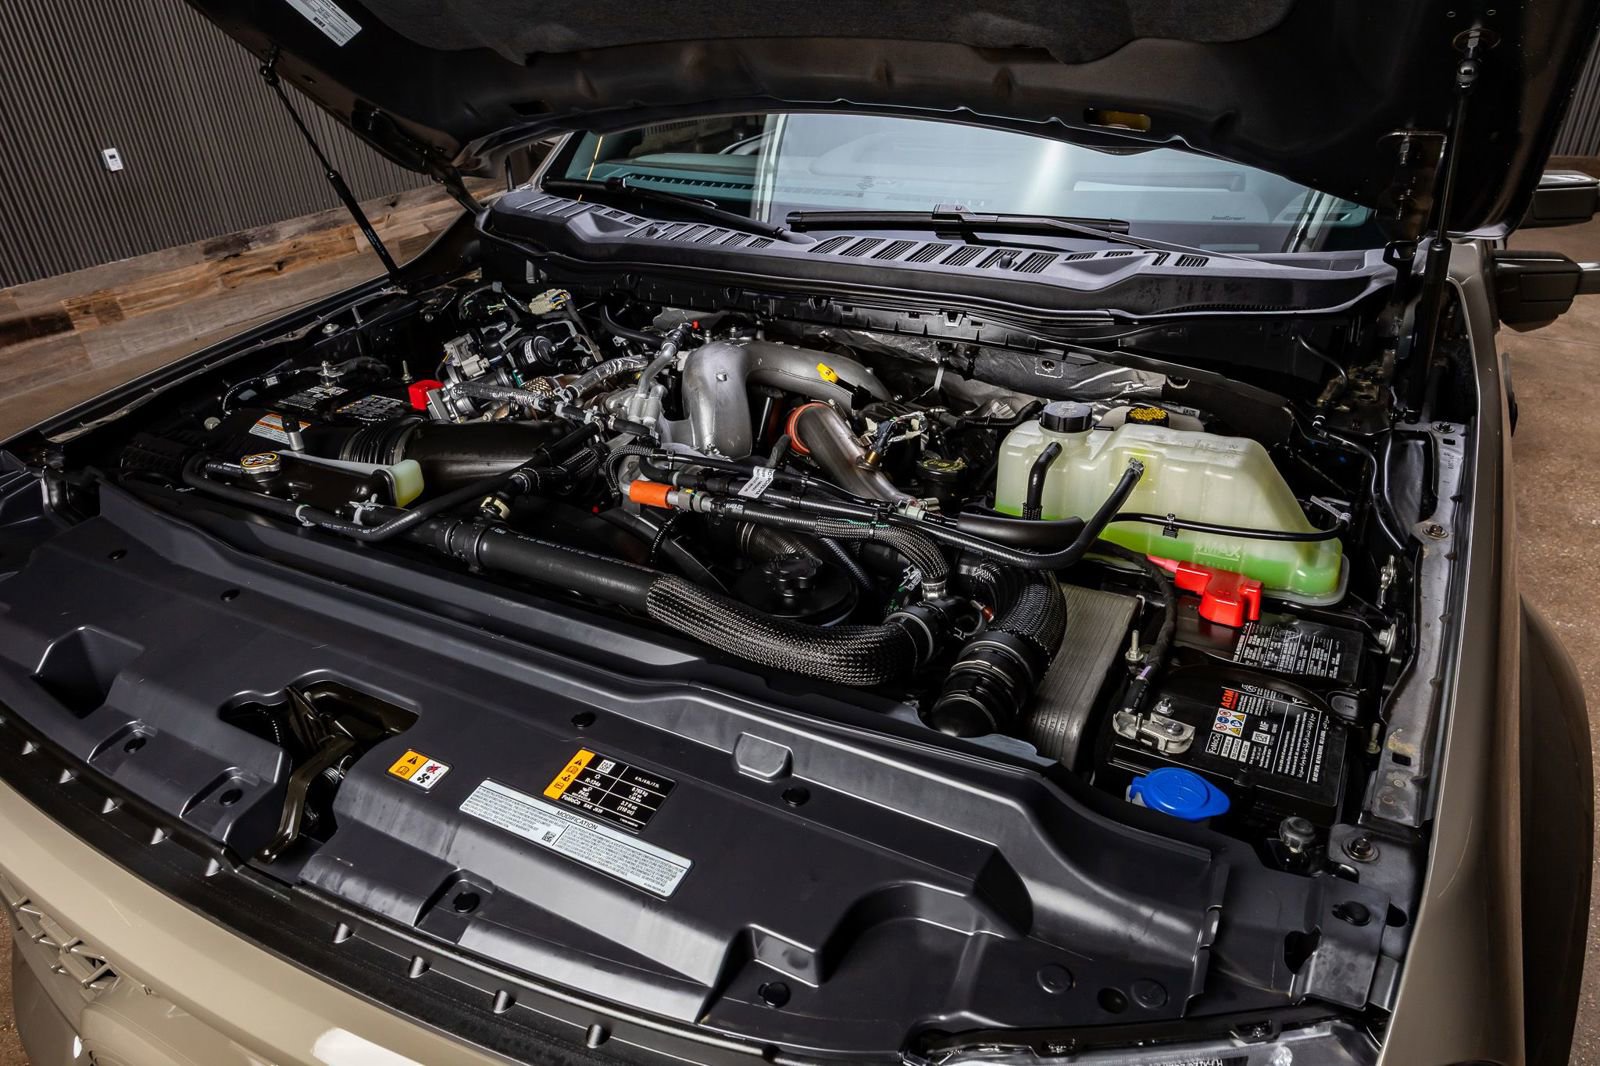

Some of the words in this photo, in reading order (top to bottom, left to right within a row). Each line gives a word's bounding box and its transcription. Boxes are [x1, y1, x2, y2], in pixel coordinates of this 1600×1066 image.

[1221, 689, 1235, 709] AGM
[1208, 733, 1221, 754] FoMoCo
[585, 777, 601, 787] R-134a
[561, 794, 581, 806] FoMoCo
[556, 810, 598, 830] MODIFICATION
